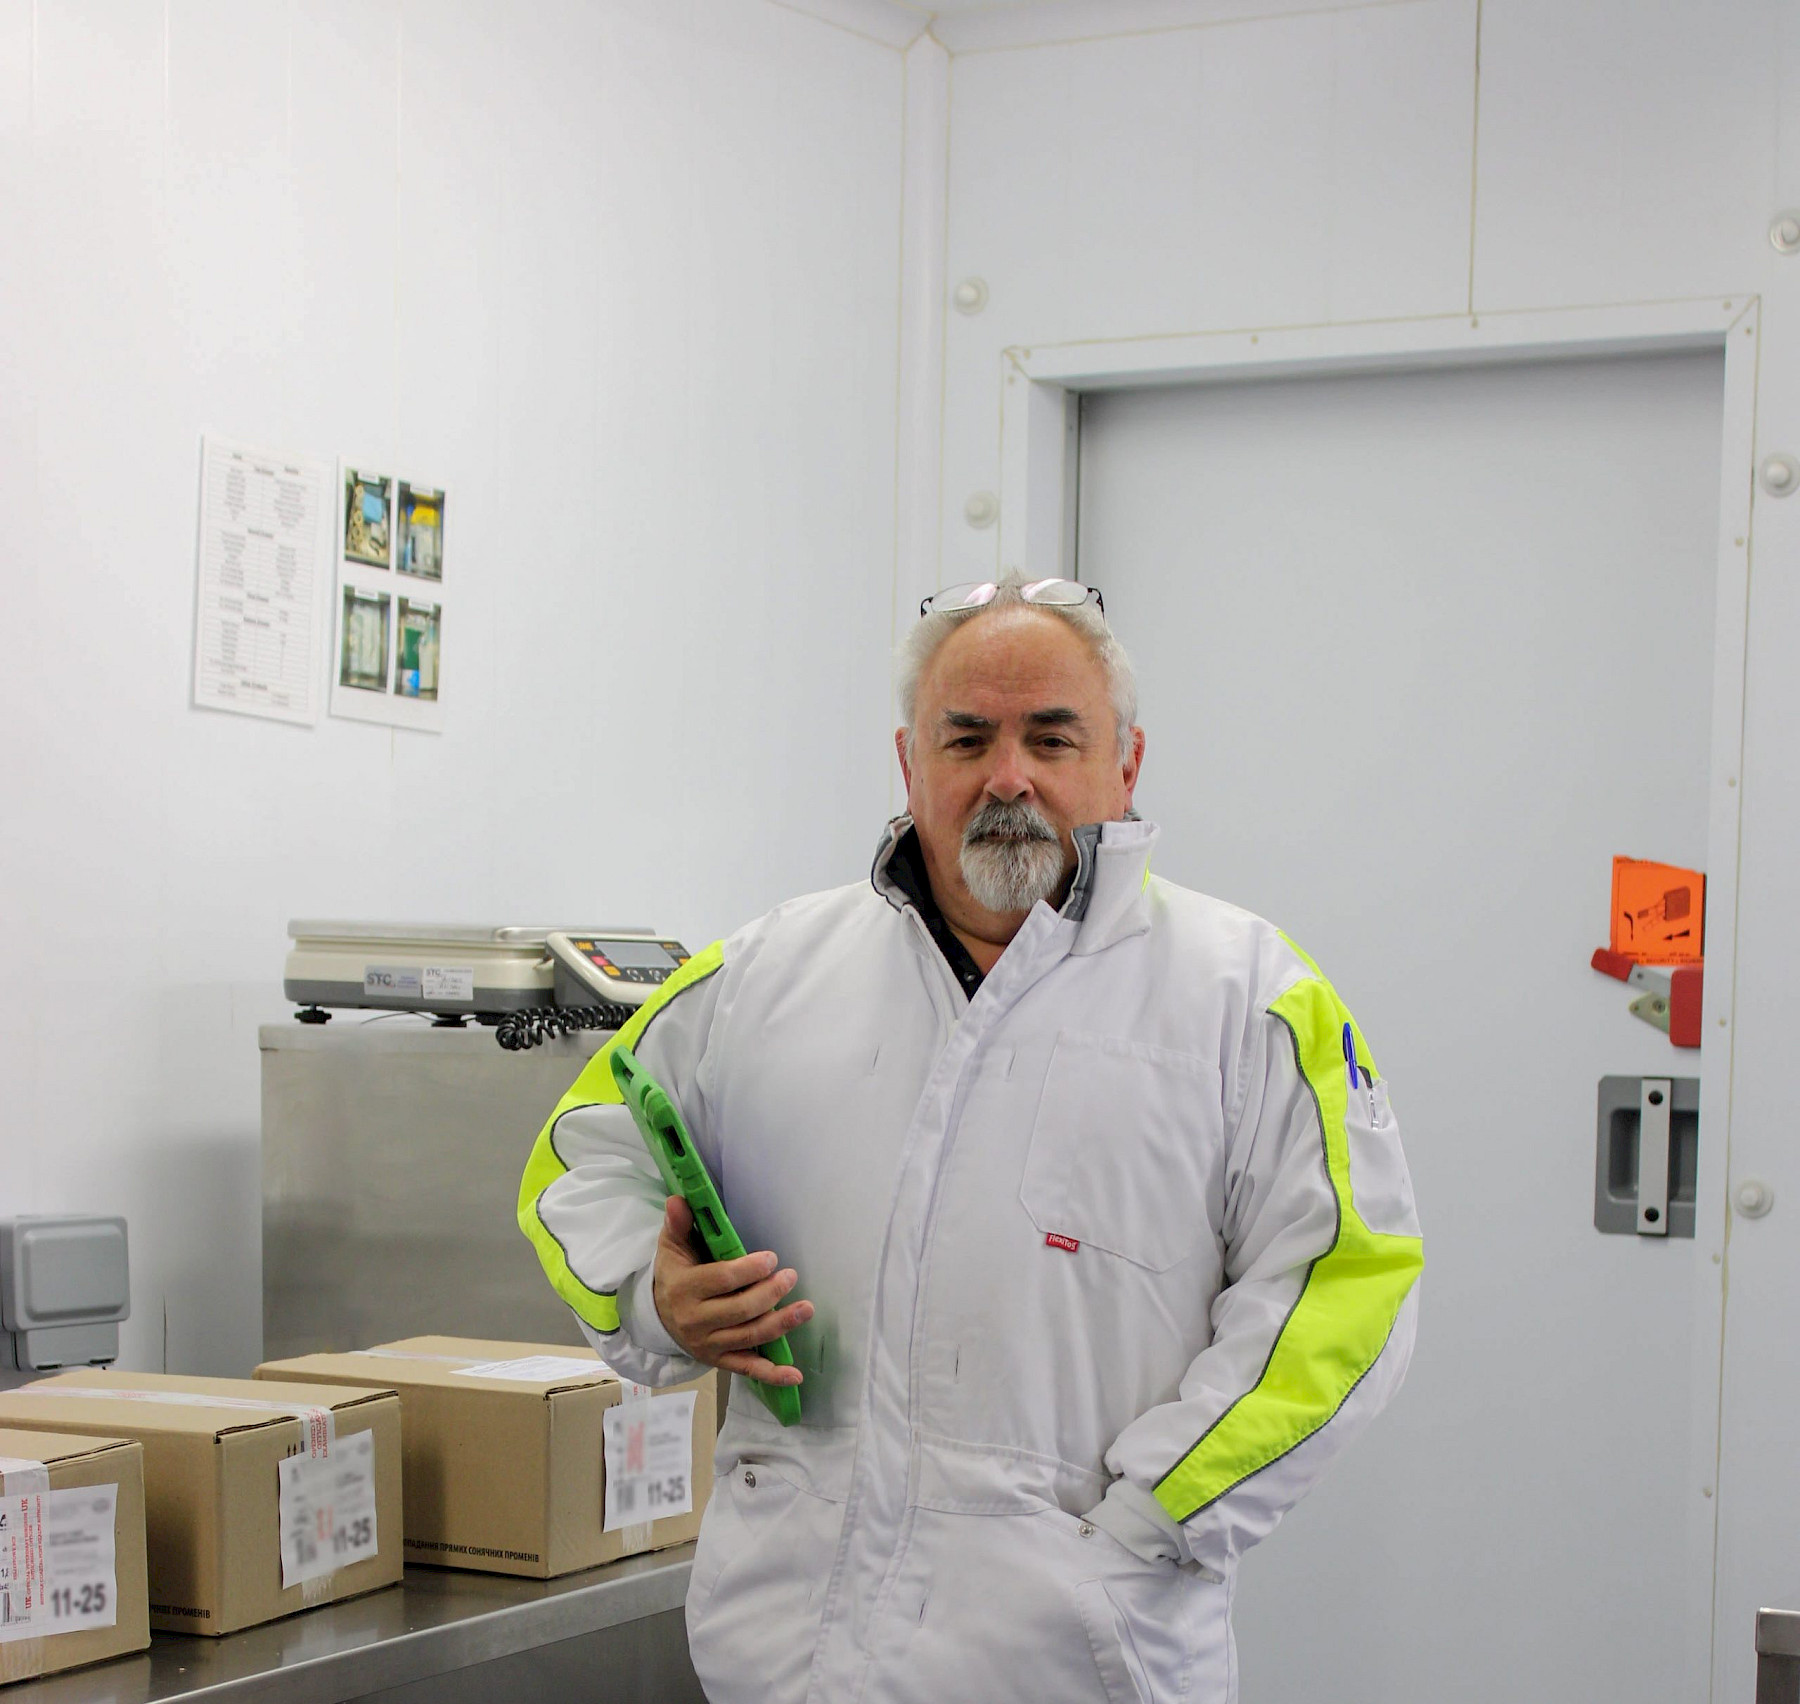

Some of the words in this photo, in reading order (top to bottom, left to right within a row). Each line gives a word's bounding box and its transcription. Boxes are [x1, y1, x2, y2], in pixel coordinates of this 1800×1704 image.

[647, 1476, 685, 1506] 11-25
[21, 1498, 28, 1512] UK
[403, 1539, 439, 1550] ОПАДАННЯ
[440, 1543, 467, 1554] ПРЯМИХ
[469, 1546, 503, 1559] СОНЯЧНИХ
[504, 1551, 540, 1563] ПРОМЕНІВ
[25, 1596, 32, 1609] UK
[51, 1583, 106, 1617] 11-25
[172, 1606, 211, 1619] ПРОМЕНІВ
